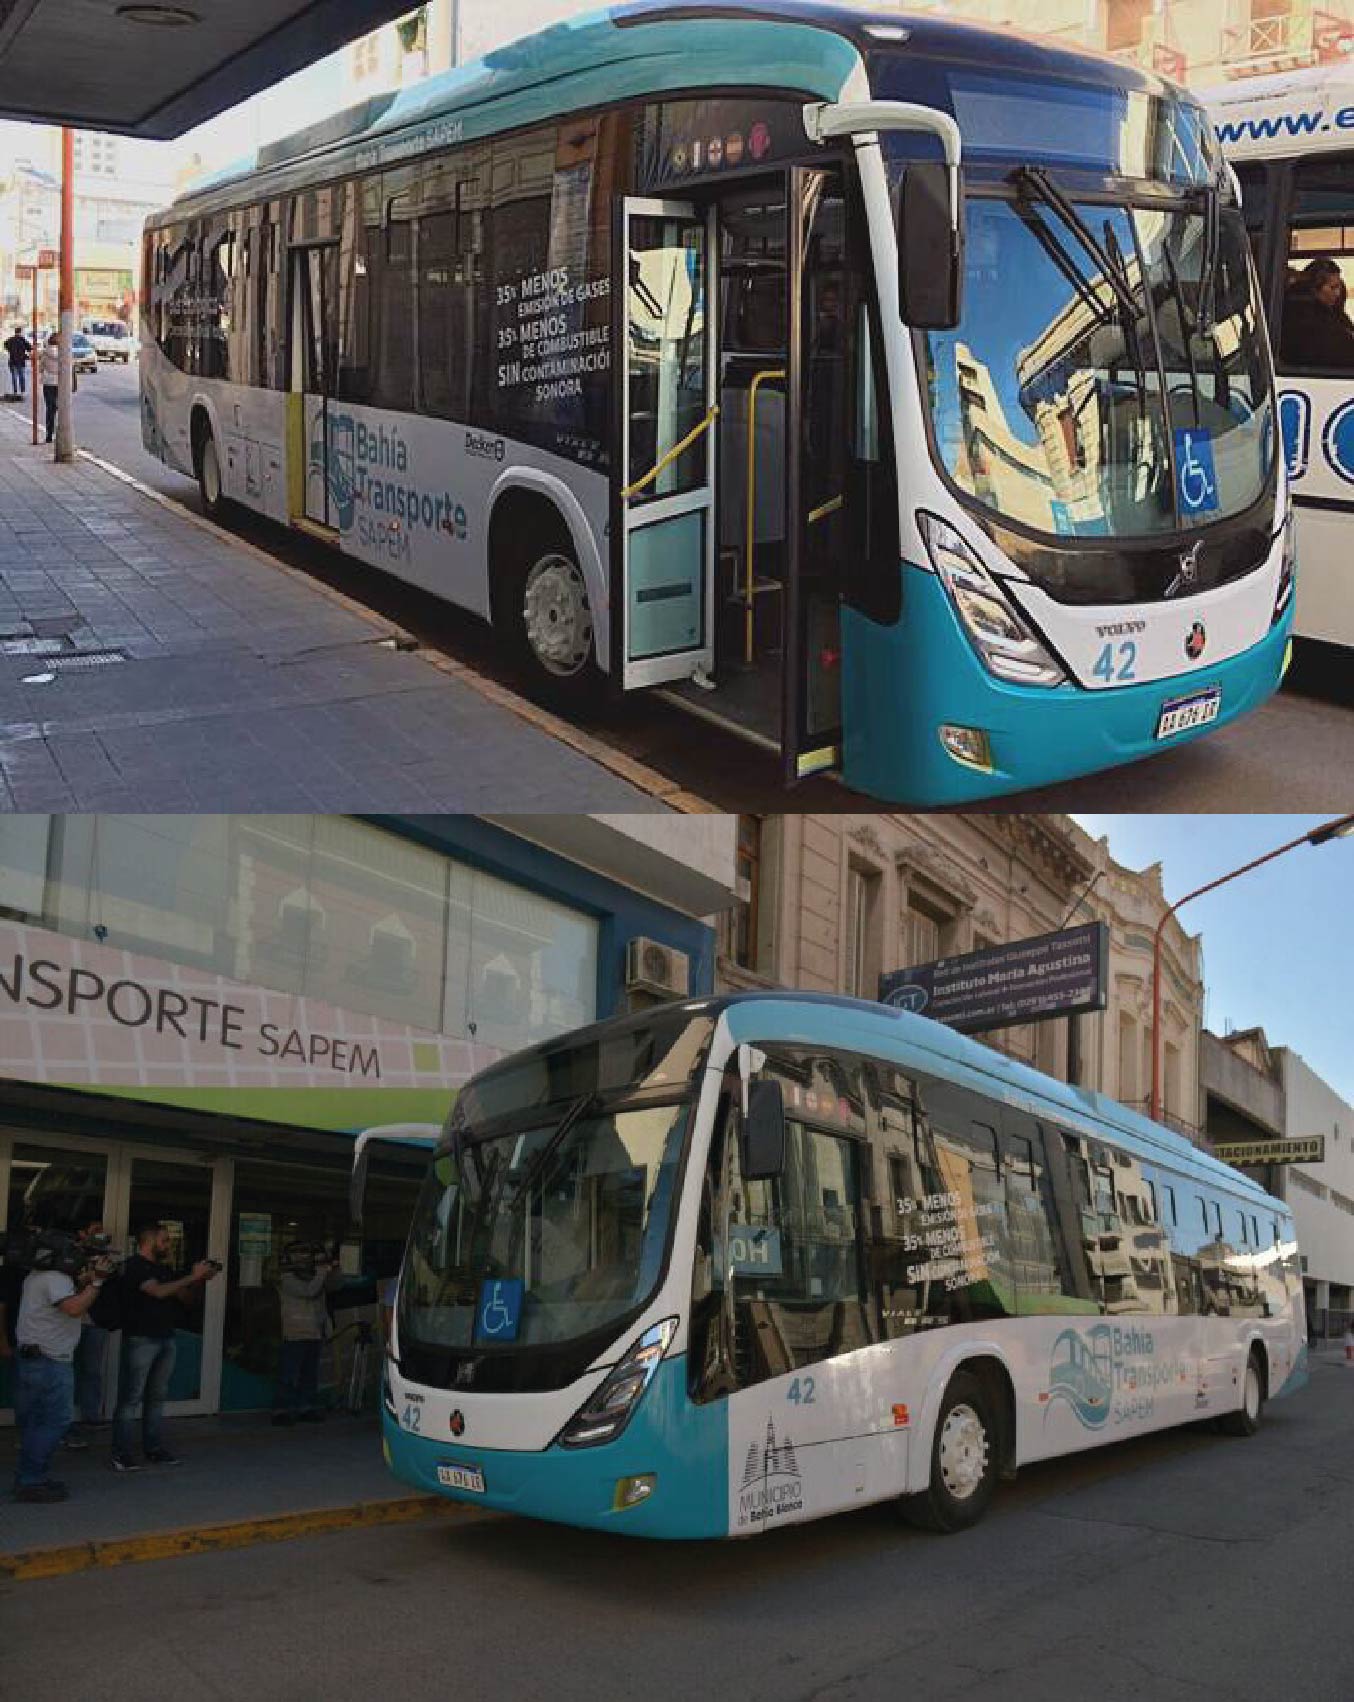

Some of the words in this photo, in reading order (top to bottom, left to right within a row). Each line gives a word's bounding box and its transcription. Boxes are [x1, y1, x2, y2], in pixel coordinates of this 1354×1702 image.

[522, 267, 568, 298] MENOS
[520, 314, 566, 342] MENOS
[538, 325, 610, 357] COMBUSTIBLE
[499, 361, 520, 386] SIN
[536, 379, 582, 402] SONORA
[357, 422, 407, 471] Bahía
[356, 465, 466, 539] Transporte
[1095, 620, 1146, 638] VOLVO
[1093, 641, 1136, 682] 42
[257, 1022, 382, 1079] SAPEM
[787, 1376, 816, 1405] 42
[402, 1405, 421, 1432] 42
[739, 1481, 801, 1512] MUNICIPIO
